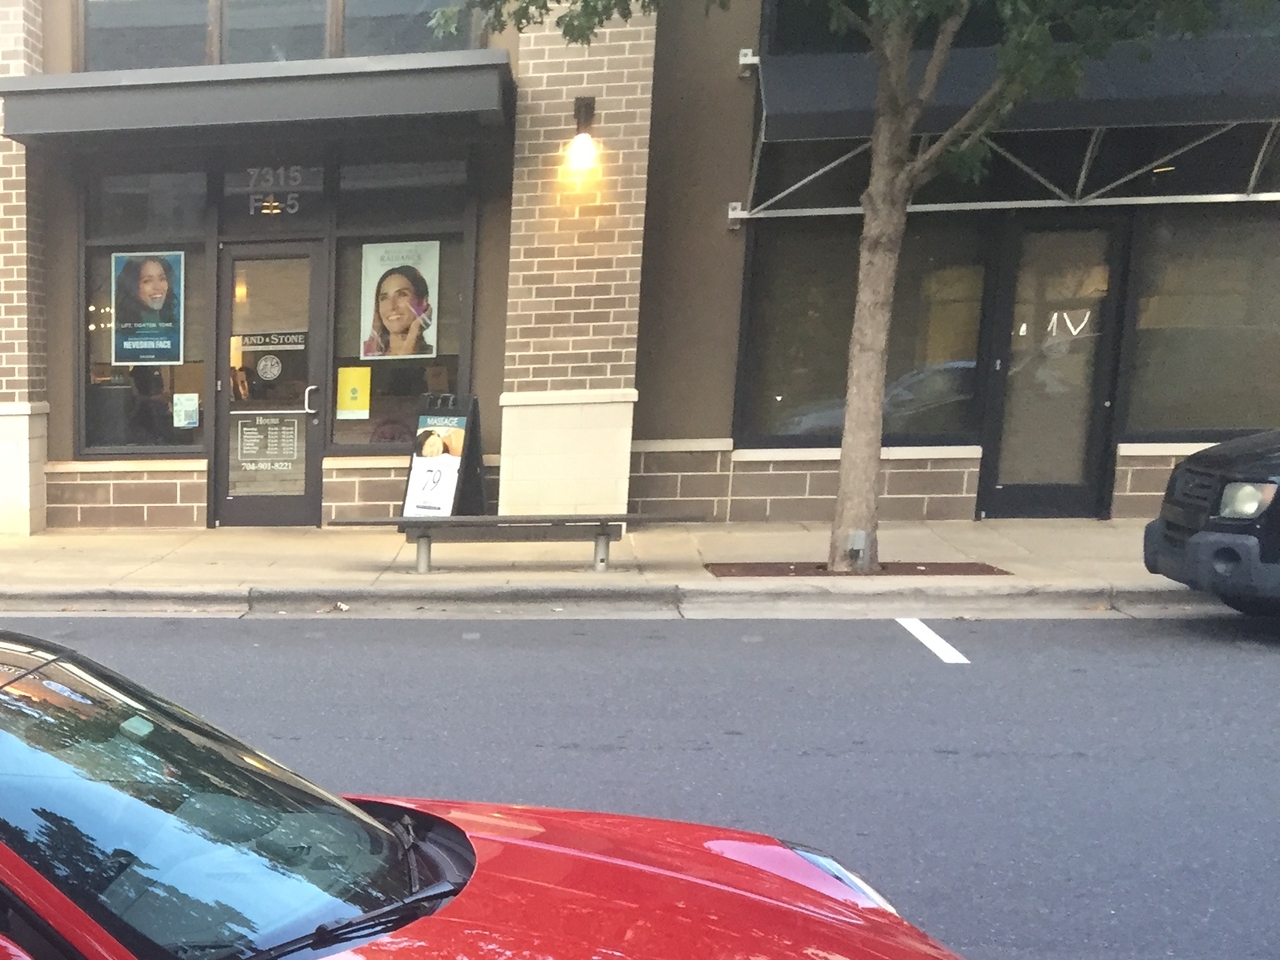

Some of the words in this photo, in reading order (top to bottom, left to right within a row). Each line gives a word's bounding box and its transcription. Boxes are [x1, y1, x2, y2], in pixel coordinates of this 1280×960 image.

[247, 165, 302, 188] 7315
[270, 333, 305, 344] STONE
[426, 416, 459, 426] MASSAGE
